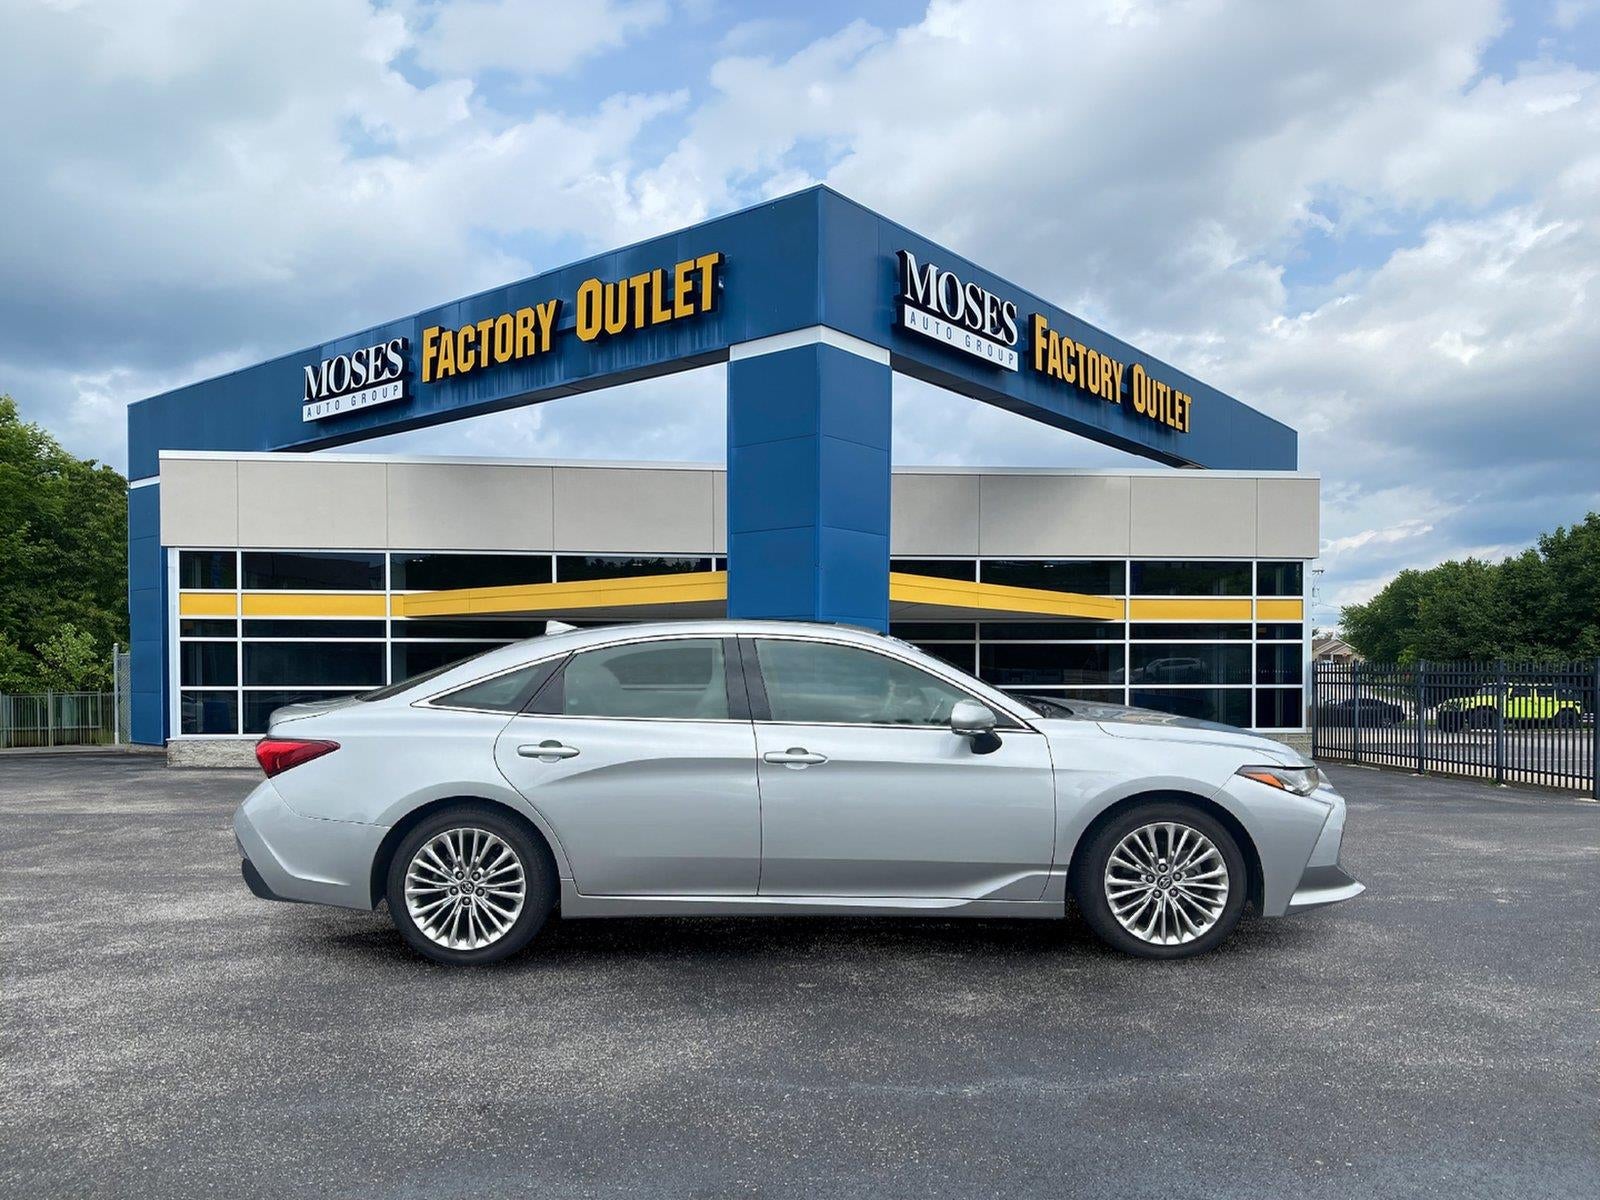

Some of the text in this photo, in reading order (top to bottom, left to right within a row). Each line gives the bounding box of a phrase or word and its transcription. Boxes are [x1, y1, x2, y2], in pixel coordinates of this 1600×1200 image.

[421, 252, 721, 383] FACTORY OUTLET
[903, 250, 1019, 346] MOSES
[909, 310, 1014, 365] AUTO GROUP
[303, 337, 404, 401] MOSES
[306, 384, 400, 418] AUTO GROUP
[1034, 312, 1192, 433] FACTORY OUTLET
